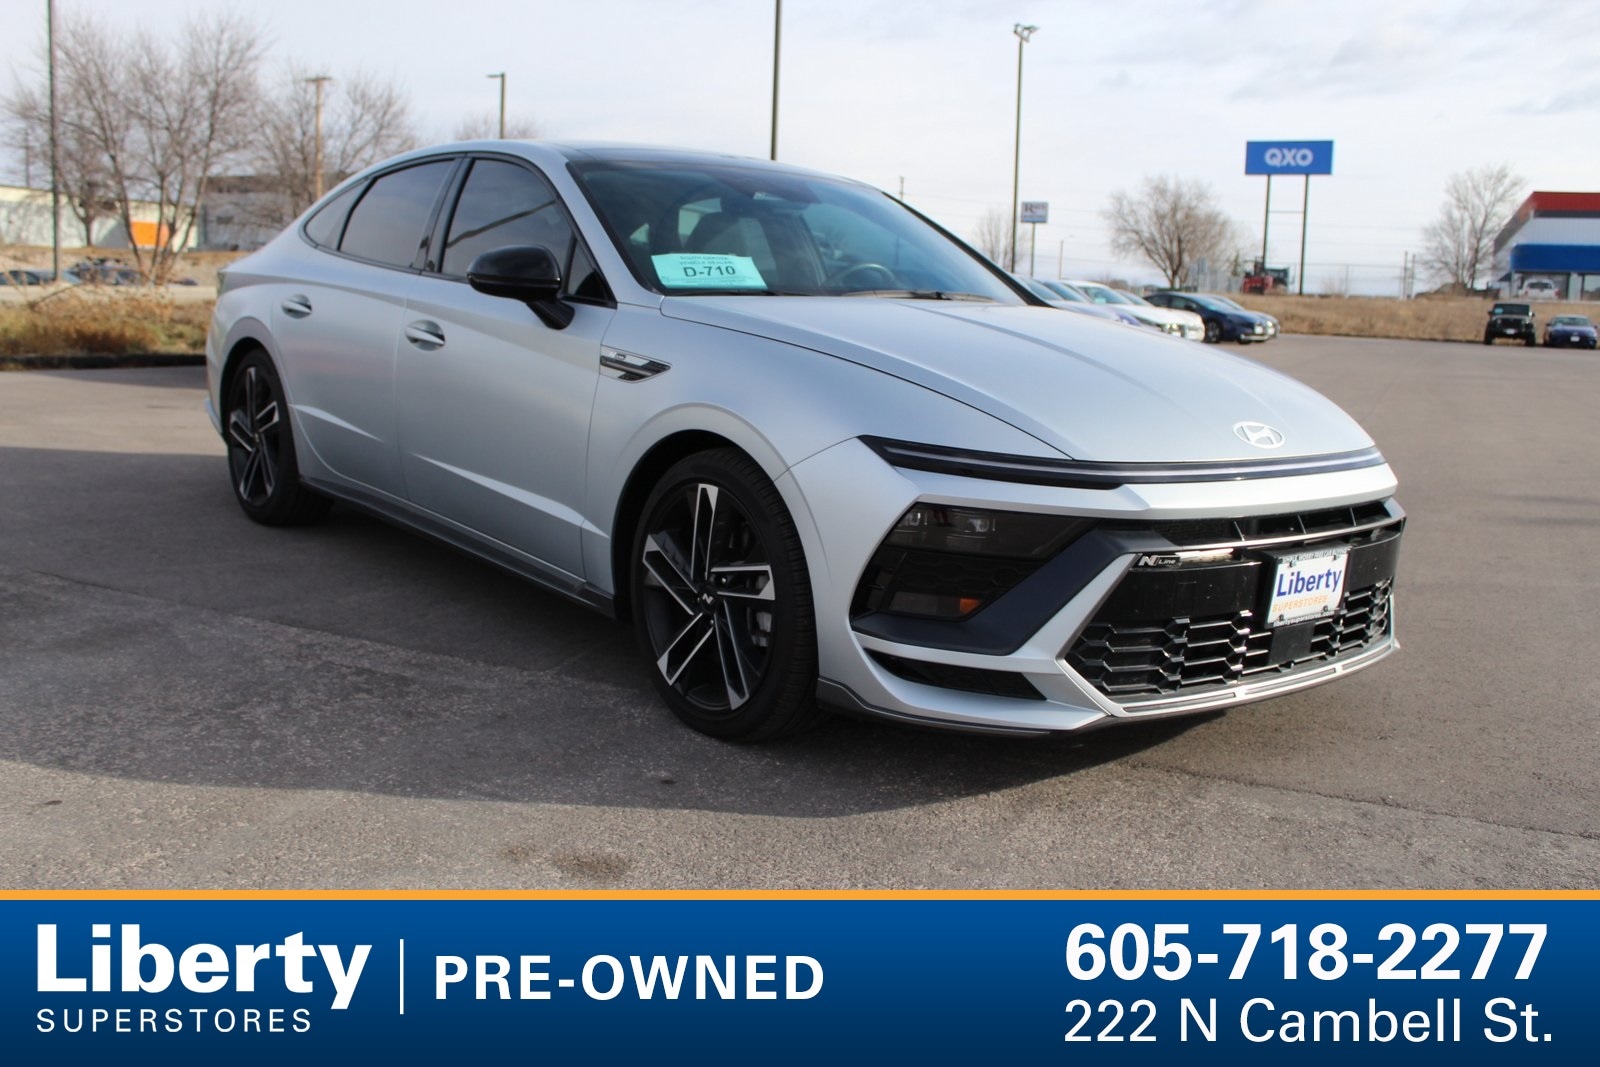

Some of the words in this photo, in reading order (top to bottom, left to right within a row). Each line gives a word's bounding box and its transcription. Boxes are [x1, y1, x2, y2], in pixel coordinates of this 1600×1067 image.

[1264, 147, 1314, 168] QXO
[683, 266, 736, 277] D-710
[1276, 568, 1342, 597] Liberty
[1271, 595, 1329, 613] SUPERSTORES
